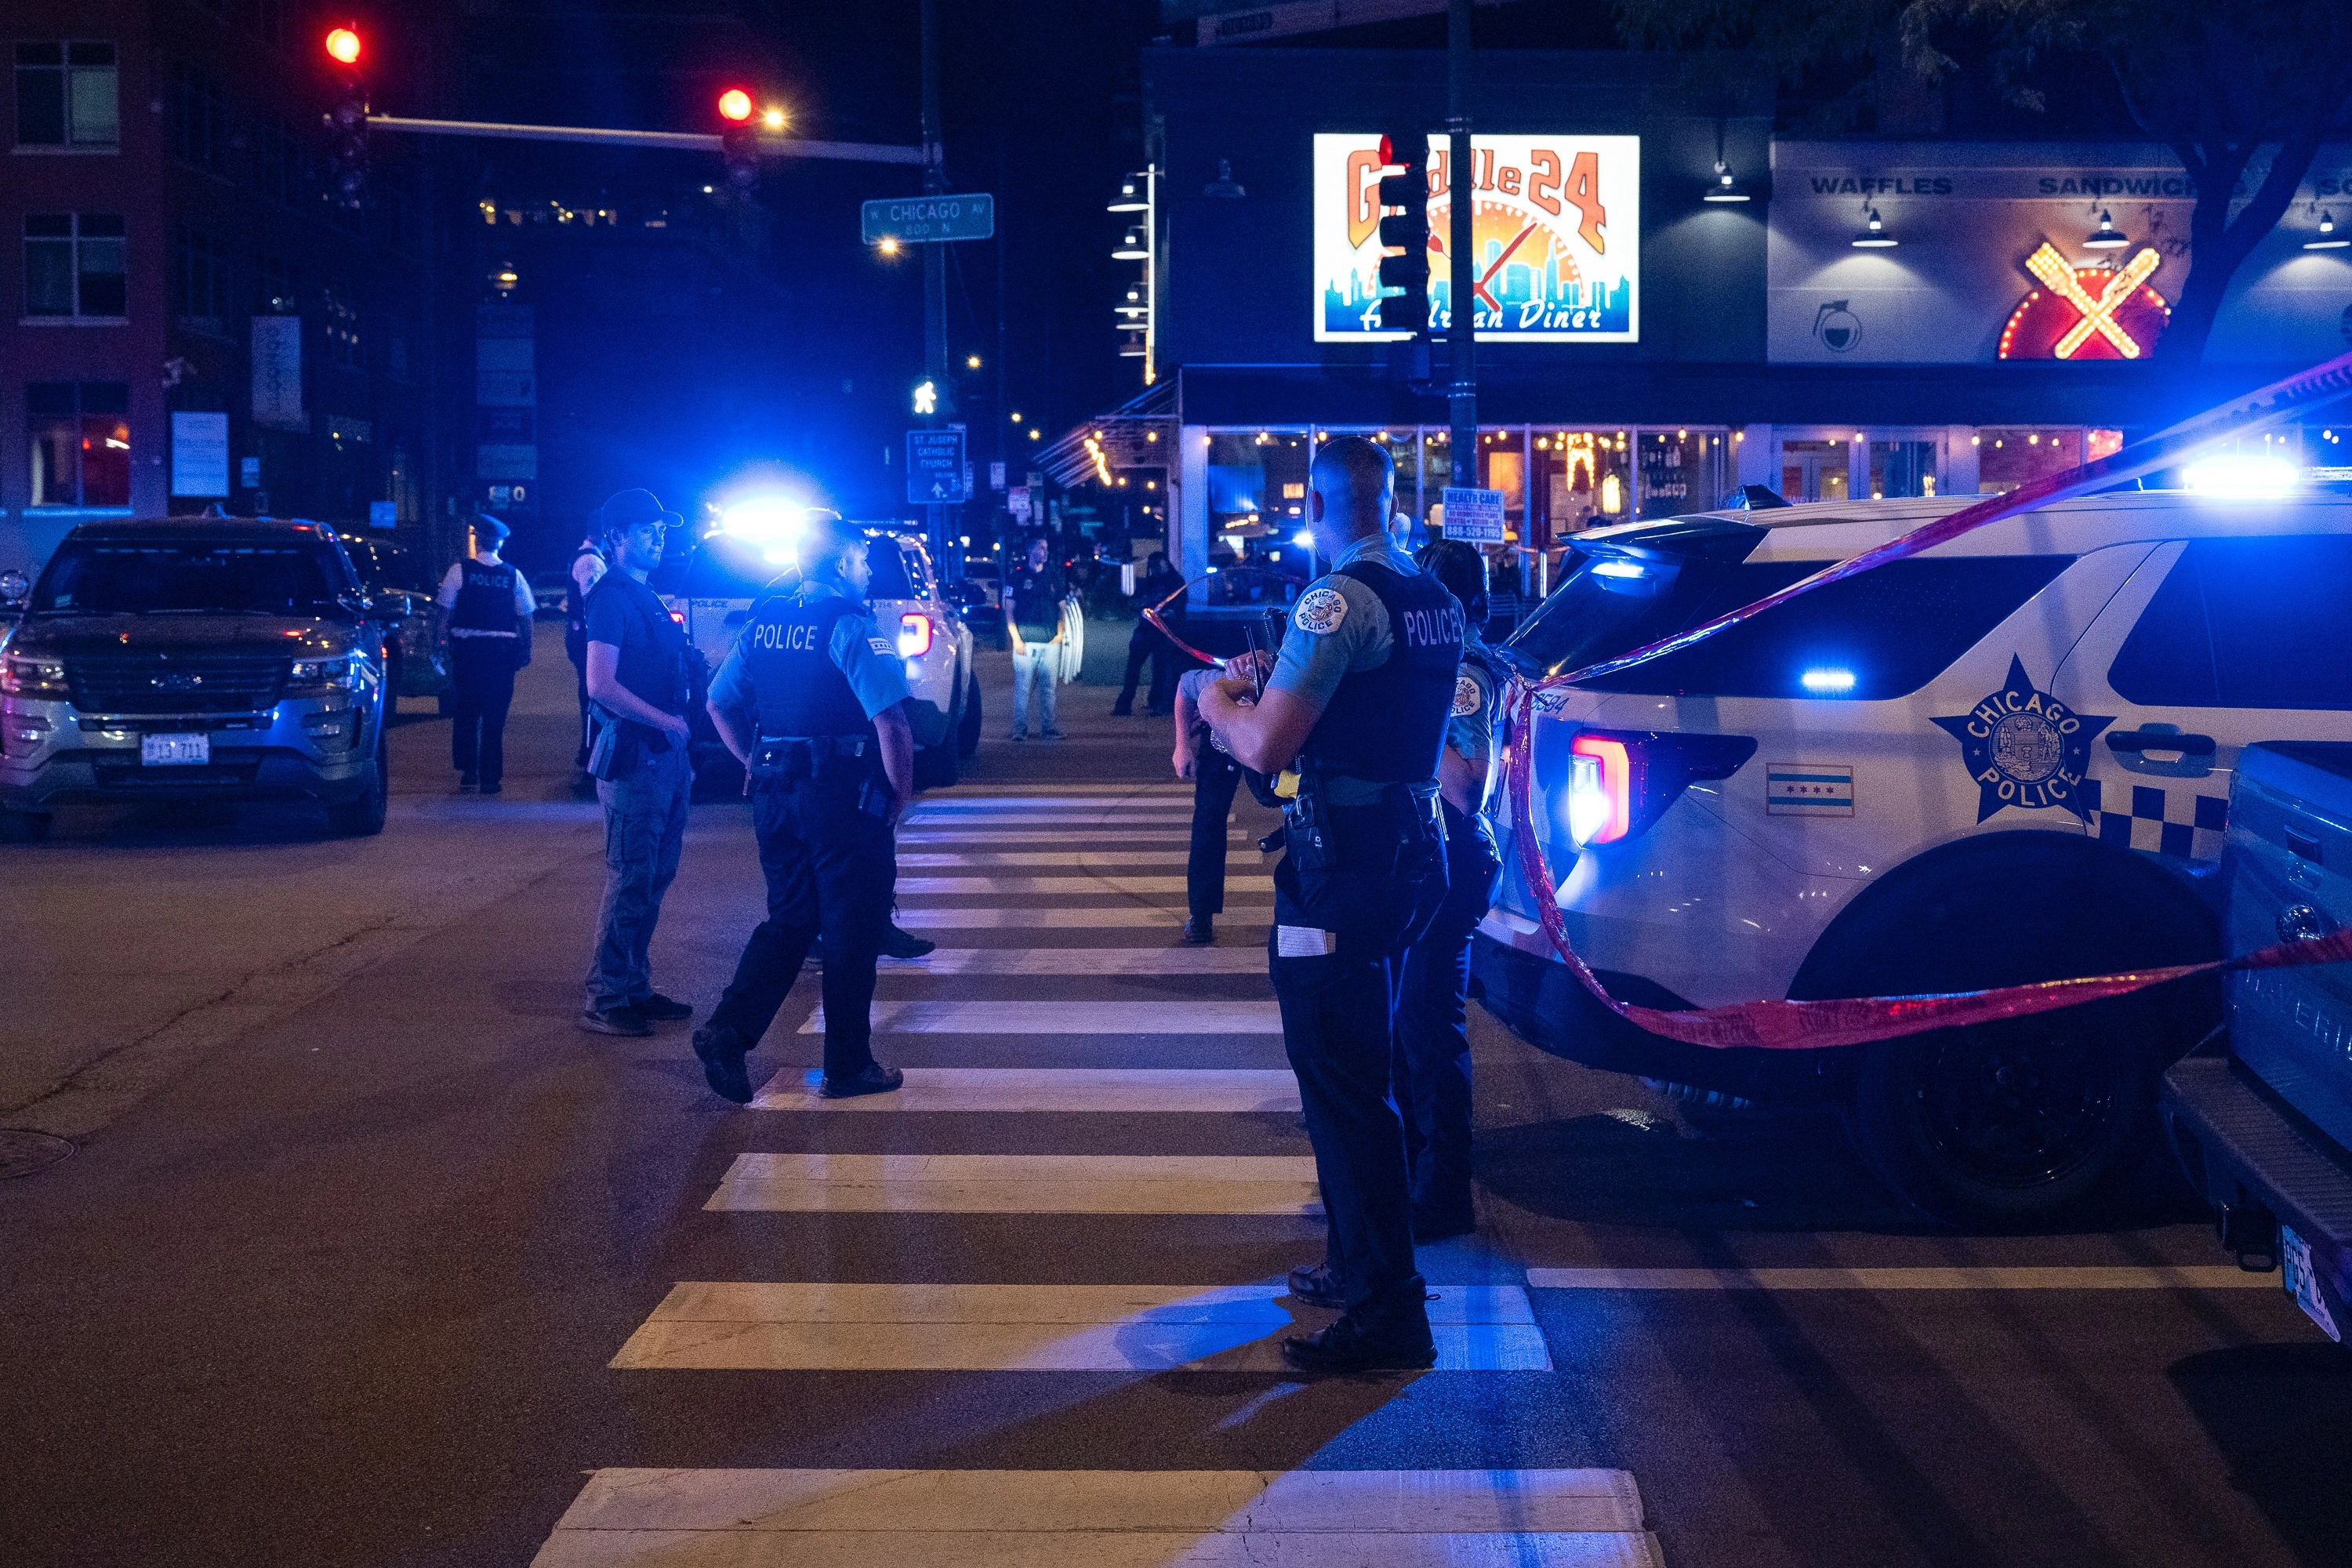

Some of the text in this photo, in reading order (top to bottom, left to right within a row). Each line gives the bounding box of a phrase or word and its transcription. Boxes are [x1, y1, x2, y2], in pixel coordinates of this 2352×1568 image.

[1810, 176, 1953, 194] WAFFLES
[2038, 176, 2247, 197] SANDWICS
[1347, 148, 1606, 255] Gdle 24
[890, 201, 960, 222] CHICAGO
[971, 202, 985, 215] AV
[905, 223, 951, 236] 800 N
[1519, 298, 1602, 329] Diner
[928, 435, 958, 445] JOSEPH
[917, 447, 955, 456] CATHOLIC
[920, 459, 953, 468] CHURCH
[1446, 492, 1500, 504] HEALTH CARE
[469, 573, 510, 589] POLICE
[1304, 590, 1341, 613] CHICAGO
[1298, 612, 1334, 630] POLICE
[1403, 608, 1460, 648] POLICE
[753, 623, 818, 651] POLICE
[1450, 700, 1475, 714] OLICE
[1967, 691, 2080, 739] CHICAGO
[1976, 766, 2082, 807] POLICE
